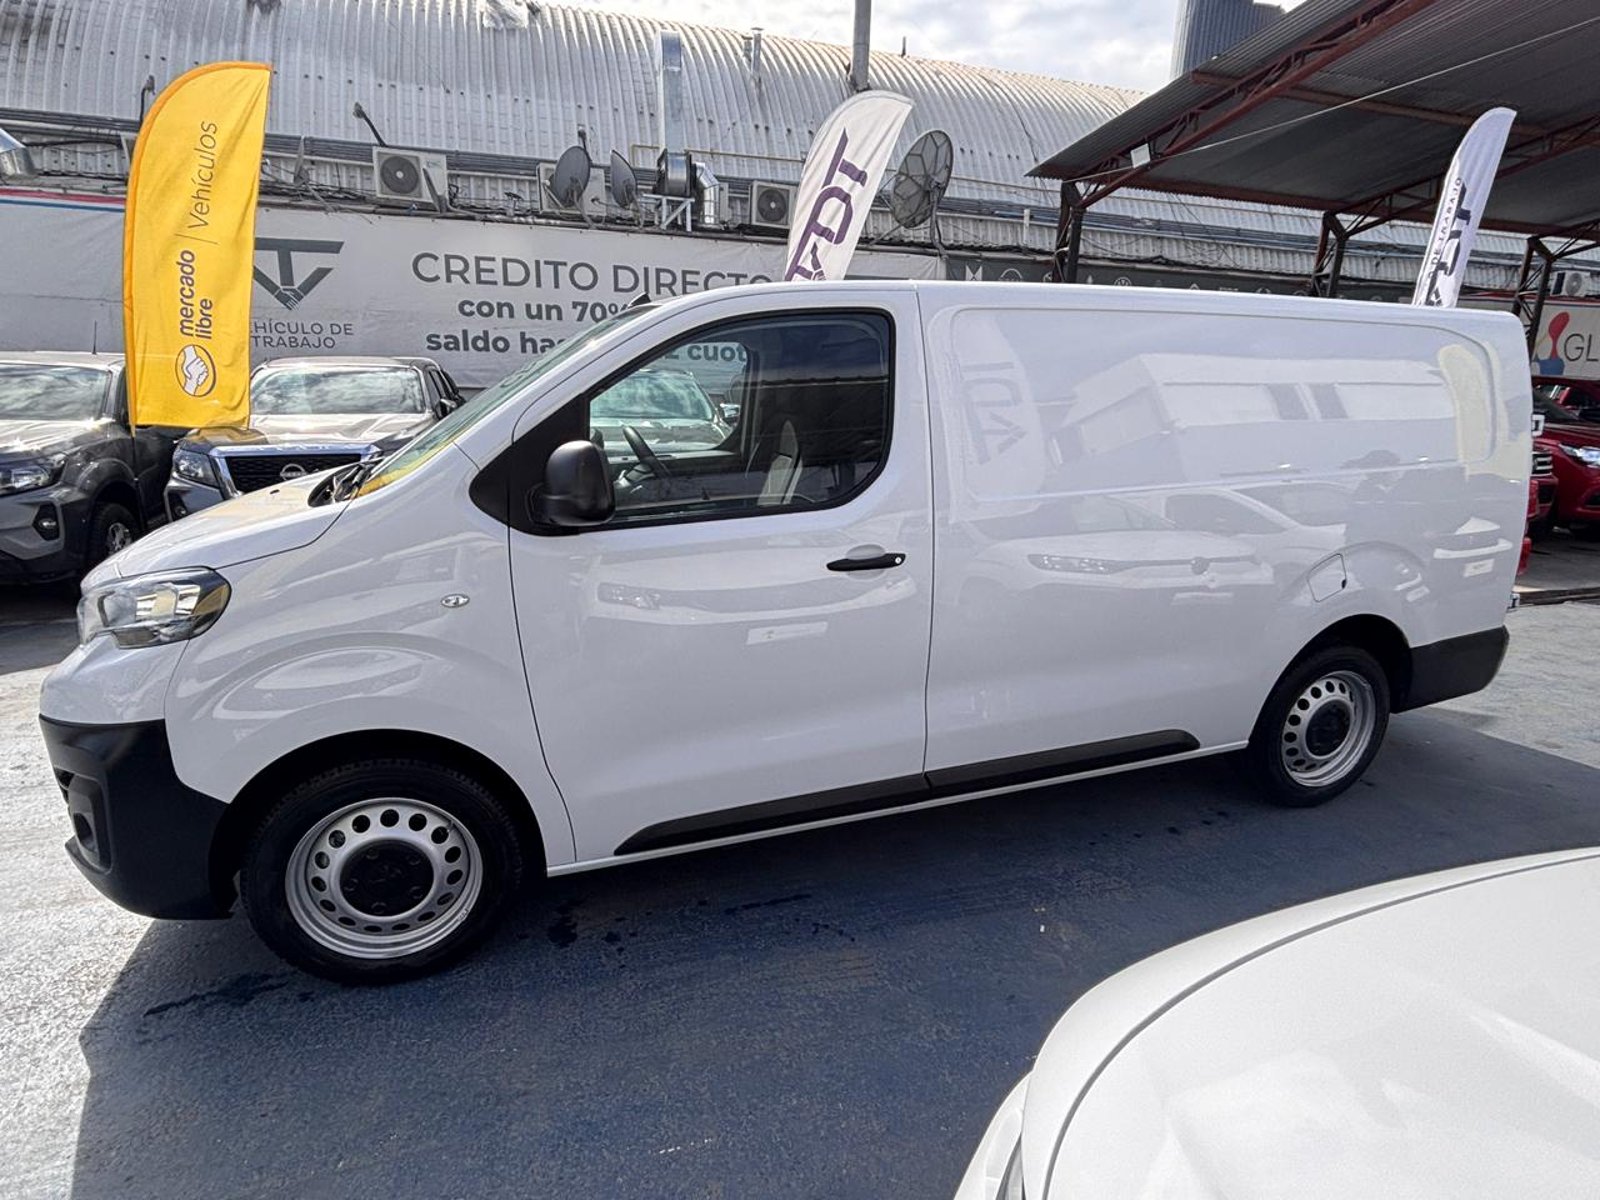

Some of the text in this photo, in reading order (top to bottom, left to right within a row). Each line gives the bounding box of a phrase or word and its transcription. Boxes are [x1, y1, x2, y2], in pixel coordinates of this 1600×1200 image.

[188, 121, 218, 229] Vehículos
[412, 252, 772, 297] CREDITO DIRECT
[177, 250, 196, 337] mercado
[196, 298, 213, 339] libre
[458, 299, 515, 319] con
[525, 303, 563, 321] un
[250, 318, 354, 335] HÍCULO DE
[251, 335, 336, 349] TRABAJO
[426, 329, 510, 354] saldo
[1564, 333, 1599, 362] GL
